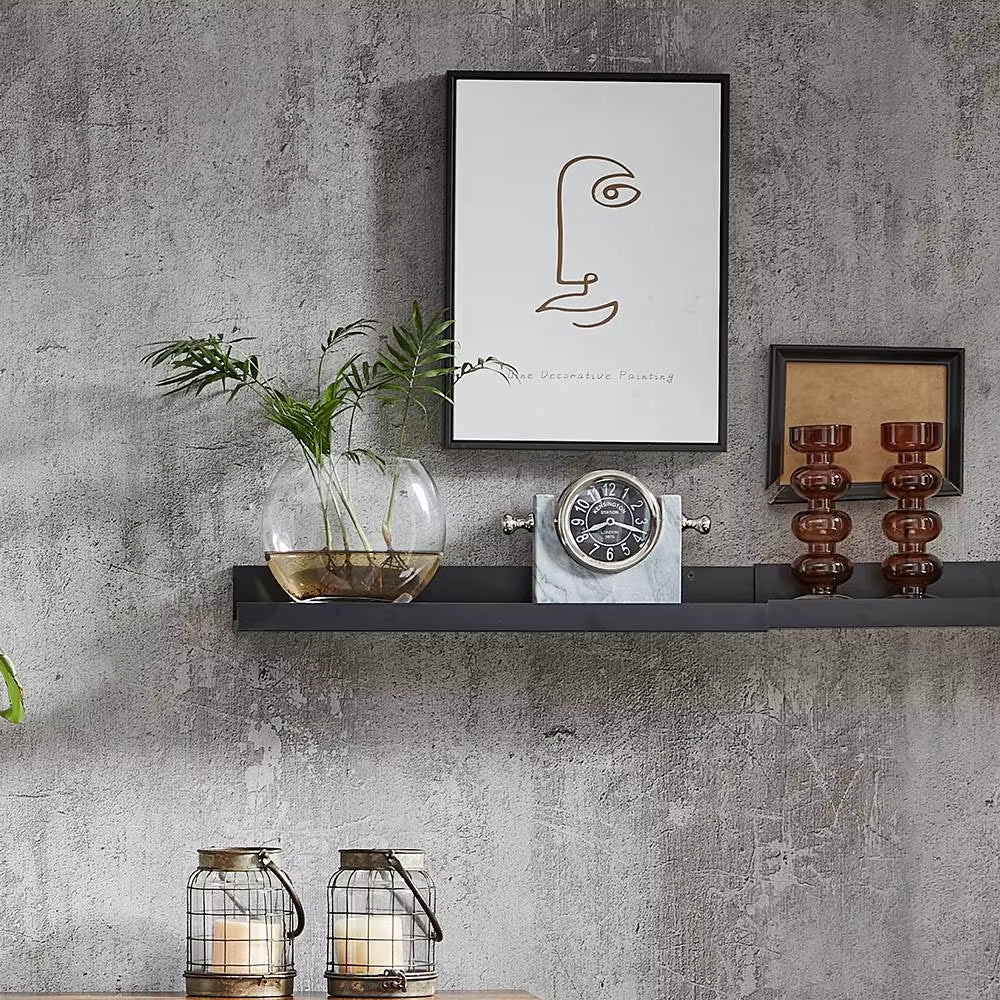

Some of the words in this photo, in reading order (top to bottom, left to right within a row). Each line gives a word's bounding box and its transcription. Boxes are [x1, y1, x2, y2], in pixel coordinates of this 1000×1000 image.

[541, 371, 611, 380] Decorative
[619, 370, 674, 383] Painting
[587, 485, 601, 501] 11
[602, 483, 616, 496] 12
[622, 488, 630, 500] 1
[574, 499, 590, 513] 10
[631, 500, 643, 511] 2
[571, 518, 585, 526] 9
[635, 517, 647, 525] 3
[576, 533, 589, 543] 8
[632, 533, 644, 543] 4
[589, 543, 600, 555] 7
[606, 547, 614, 561] 6
[621, 542, 630, 556] 5
